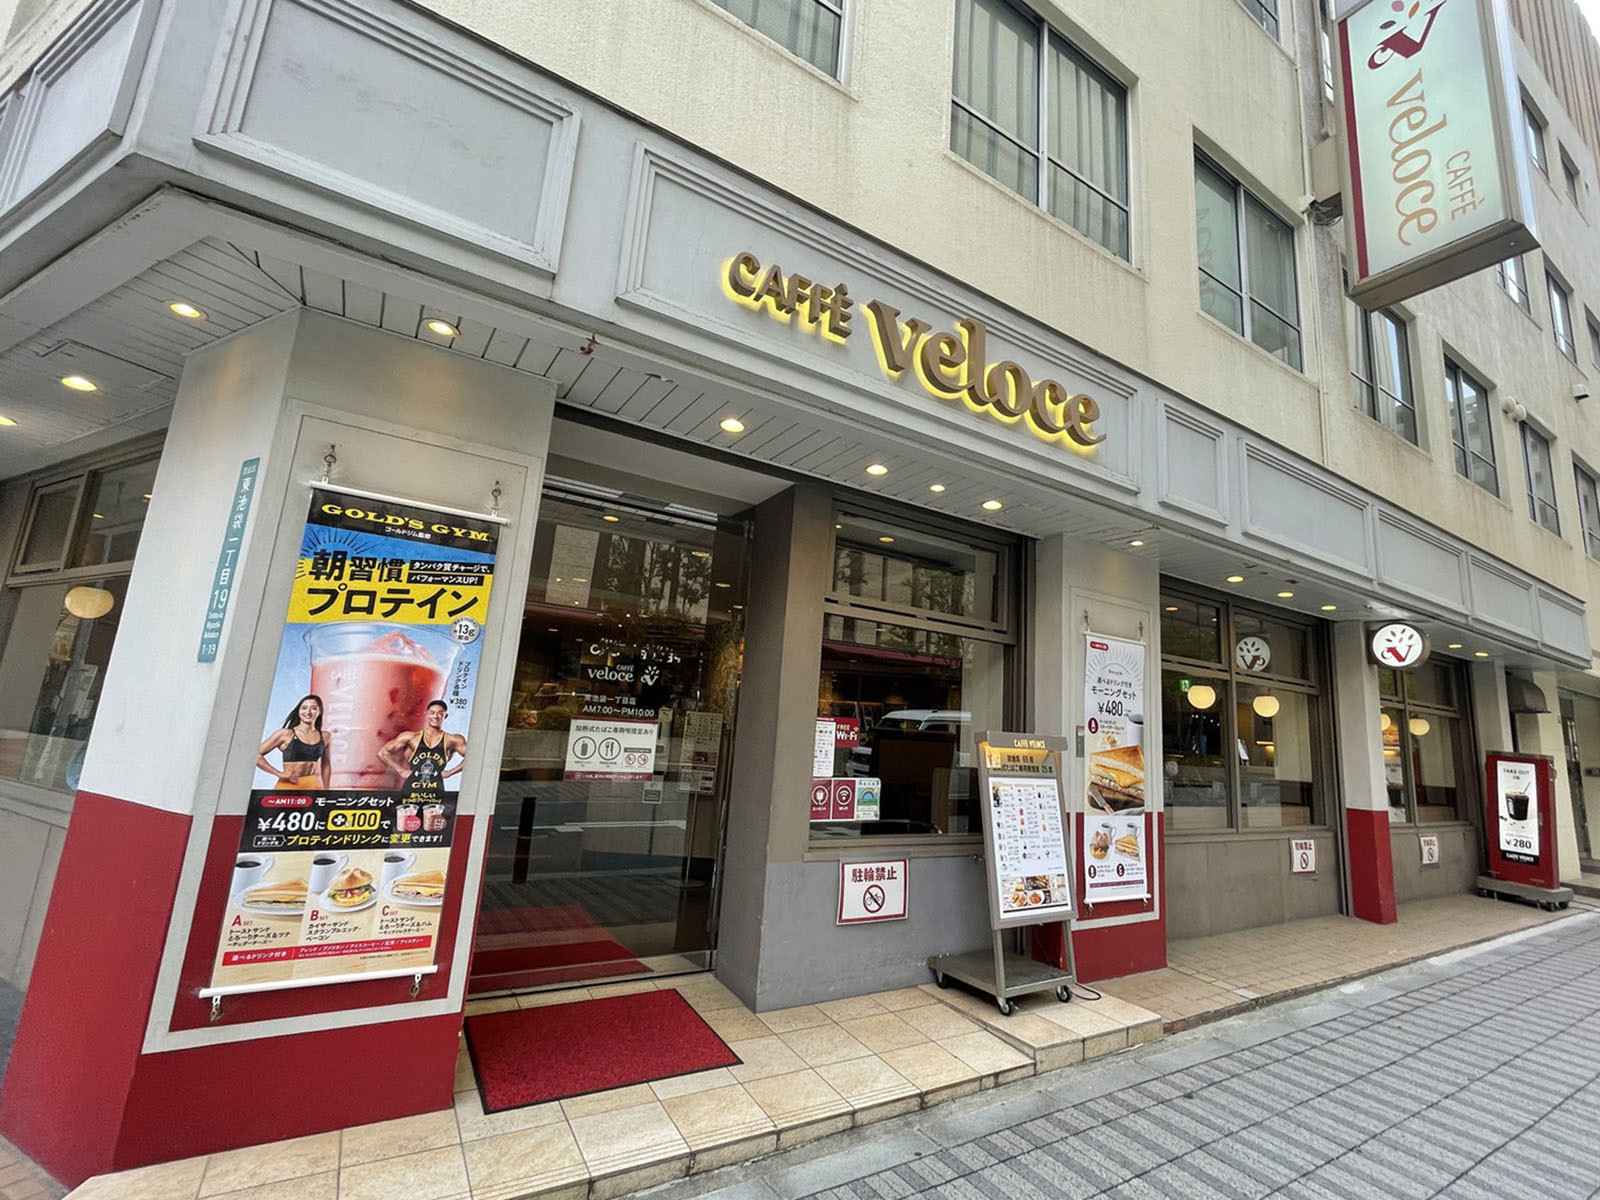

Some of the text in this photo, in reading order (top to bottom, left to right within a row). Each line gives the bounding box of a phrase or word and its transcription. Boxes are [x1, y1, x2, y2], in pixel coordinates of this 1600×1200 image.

[1386, 68, 1447, 246] veloce
[321, 503, 490, 542] GOLD'S GYM
[309, 549, 405, 584] 朝習慣
[412, 561, 490, 574] タンパク質チャージで、
[411, 575, 479, 585] パフォーマンスUP!
[307, 583, 479, 619] プロテイン
[587, 666, 635, 683] veloce
[1091, 685, 1137, 701] モーニングセット
[1097, 699, 1123, 717] ¥480
[836, 723, 850, 731] FREE
[836, 730, 858, 741] Wi-Fi
[1503, 767, 1517, 775] TAKE
[411, 780, 438, 789] GYM
[315, 796, 395, 808] モーニングセット
[1504, 838, 1532, 850] ¥280
[851, 866, 898, 883] 駐輪禁止
[310, 909, 320, 921] B
[382, 904, 390, 916] C
[231, 914, 242, 926] A
[308, 921, 349, 929] カイザーサンド
[229, 926, 271, 935] トーストサンド
